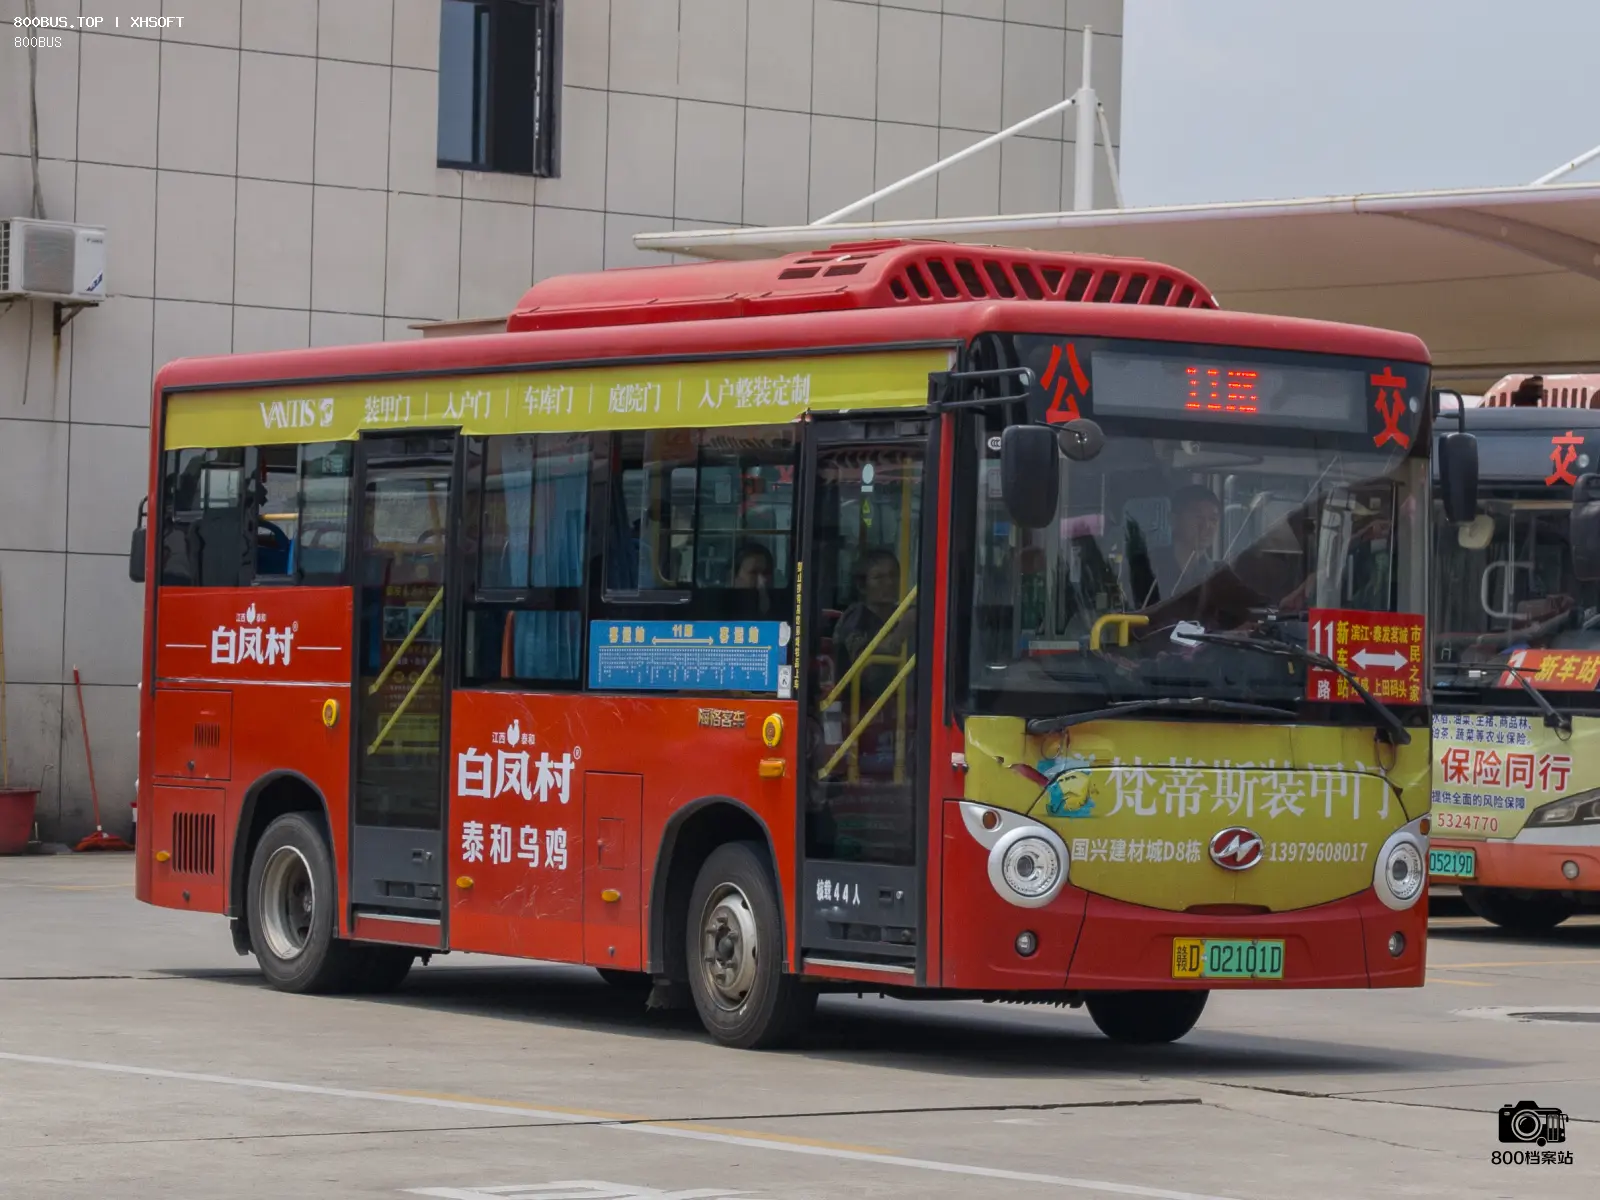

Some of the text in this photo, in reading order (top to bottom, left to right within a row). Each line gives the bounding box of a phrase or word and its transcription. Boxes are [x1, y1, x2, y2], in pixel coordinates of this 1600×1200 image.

[364, 394, 411, 424] 装甲门
[522, 384, 574, 416] 车库门
[607, 381, 661, 413] 庭院门
[1040, 342, 1090, 424] 公
[1371, 366, 1409, 449] 交
[1544, 430, 1585, 486] 交
[210, 625, 295, 666] 白凤村
[1312, 620, 1334, 672] 11
[1336, 620, 1350, 699] 新车站
[1409, 624, 1423, 702] 市民之家
[1317, 679, 1331, 701] 路
[1534, 654, 1600, 684] 新车站
[491, 731, 536, 746] 江西 泰和
[457, 747, 576, 805] 白凤村
[1104, 755, 1392, 820] 梵蒂斯装甲门
[1440, 747, 1572, 792] 保险同行
[1437, 812, 1499, 833] 5324770
[461, 820, 568, 871] 泰和乌鸡
[1071, 838, 1203, 864] 国兴建材城D8栋
[1269, 842, 1369, 863] 13979608017
[1209, 945, 1282, 974] 02101D
